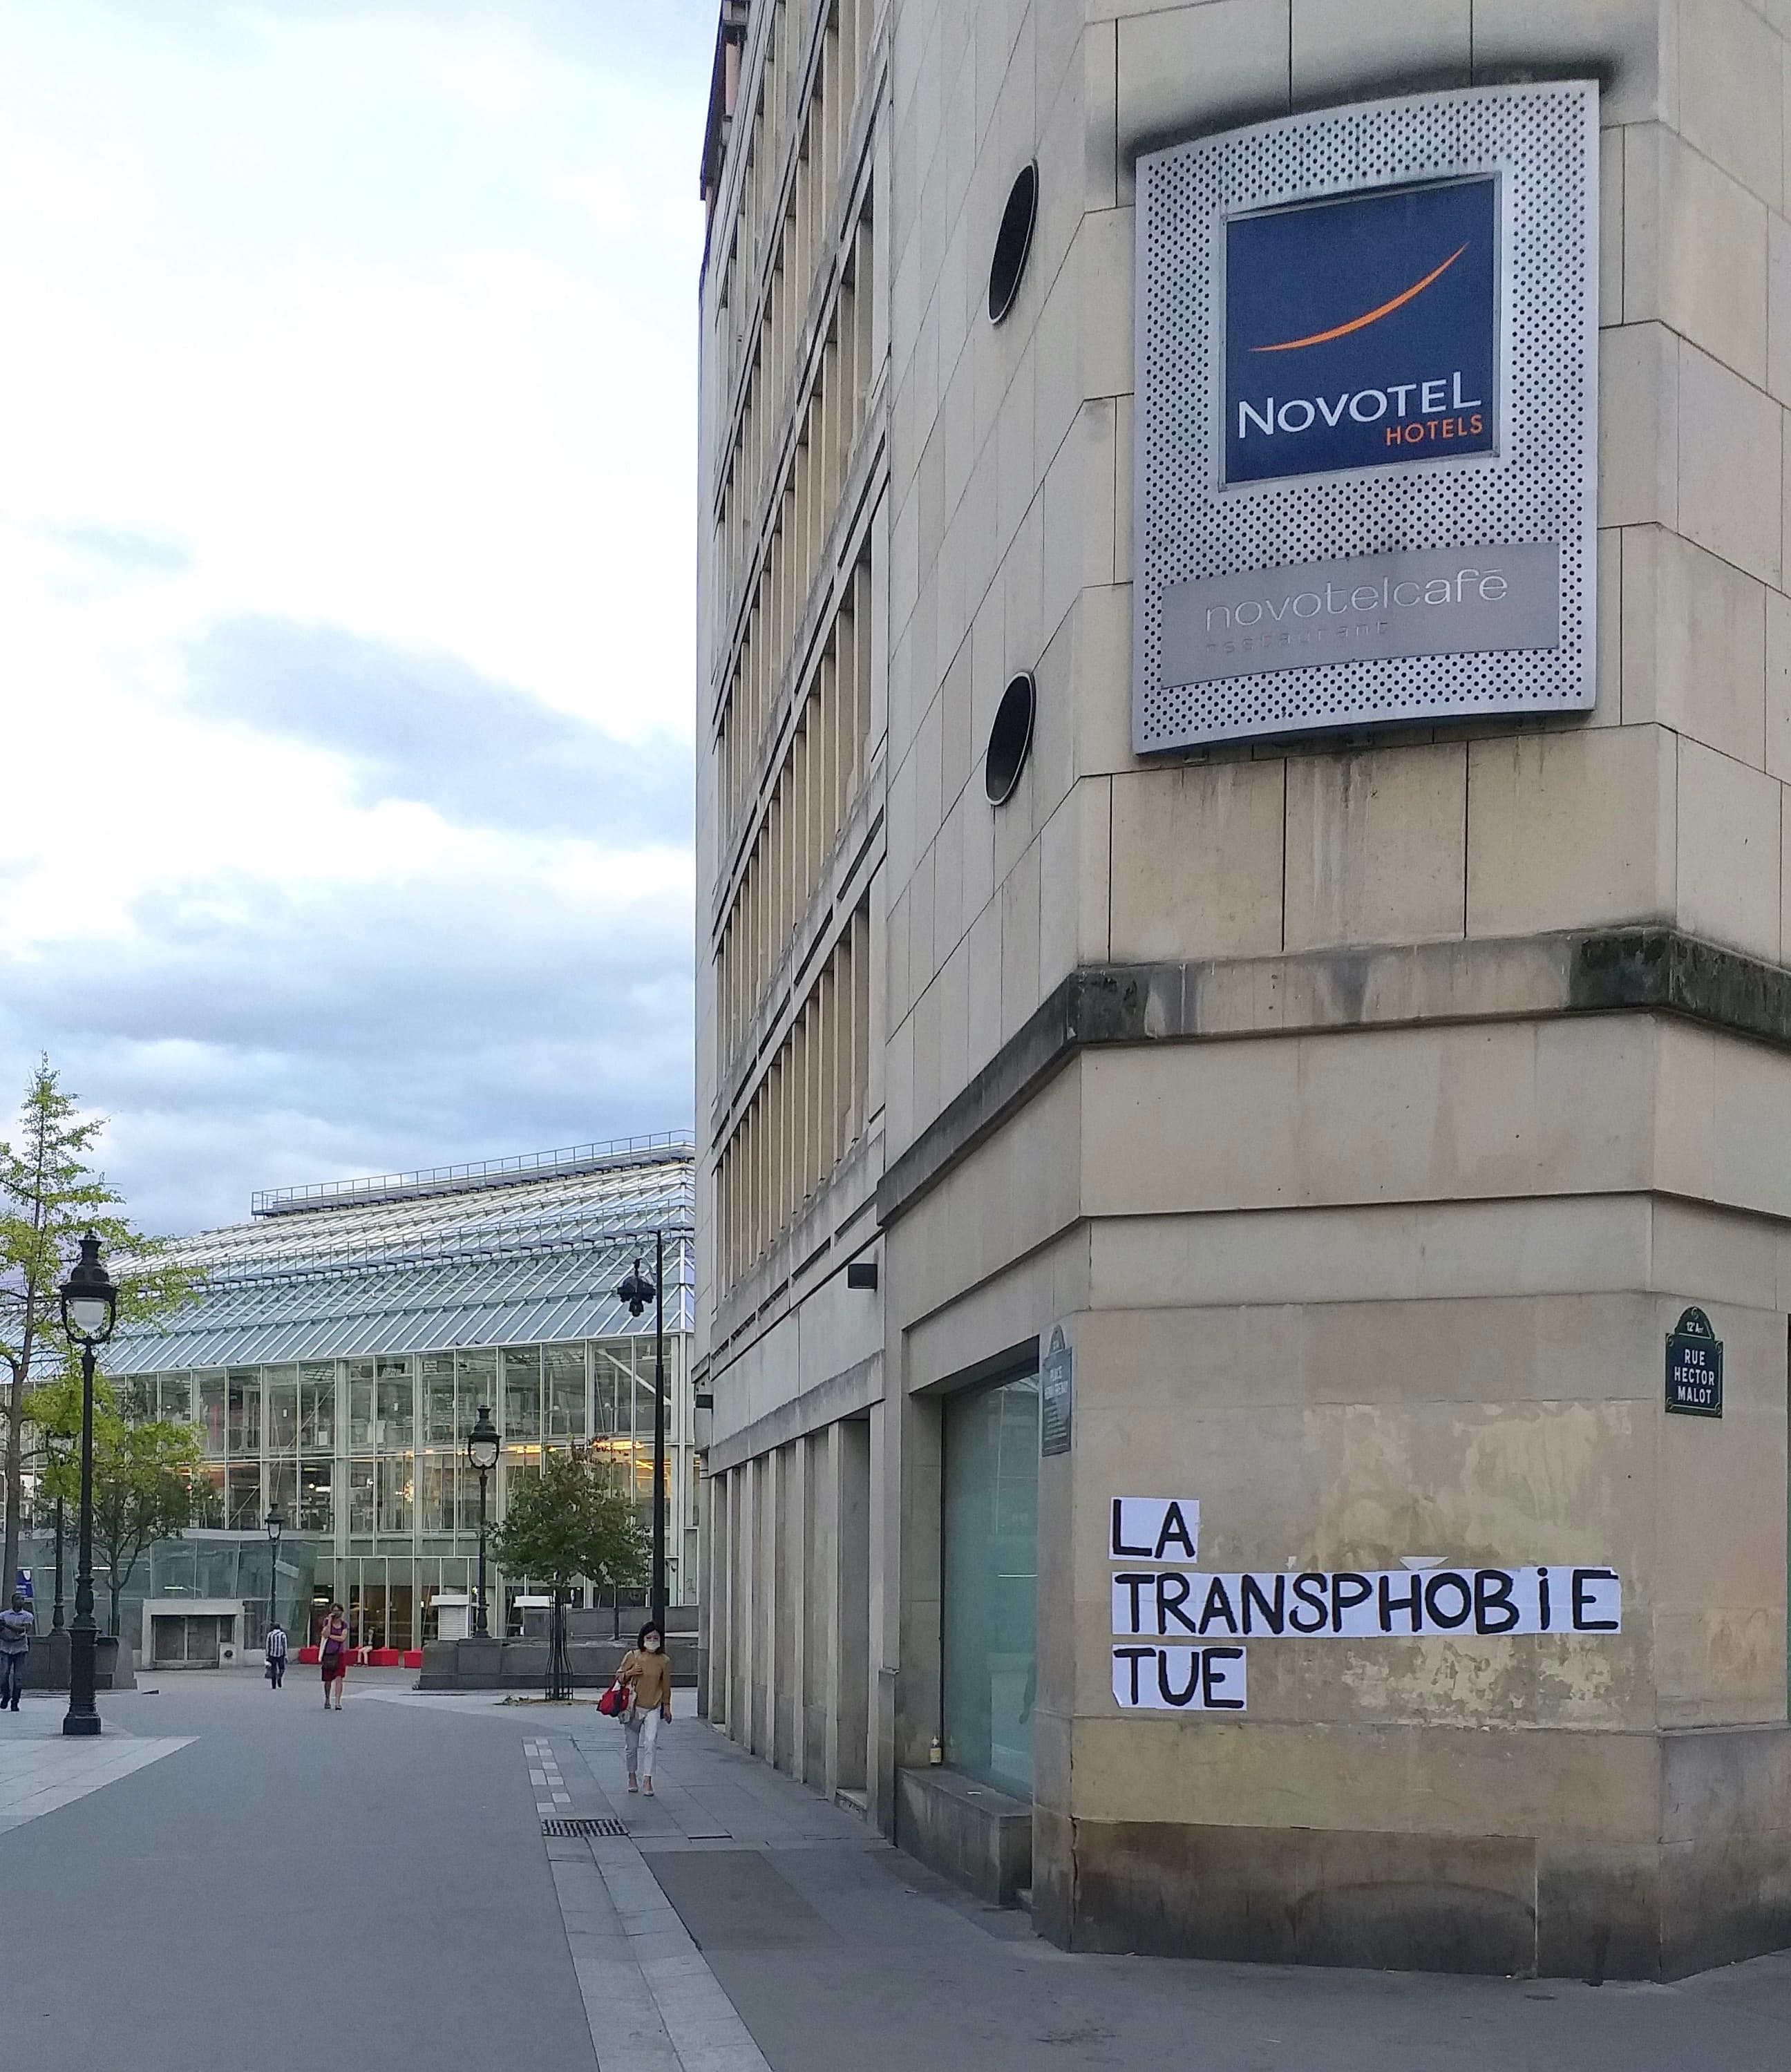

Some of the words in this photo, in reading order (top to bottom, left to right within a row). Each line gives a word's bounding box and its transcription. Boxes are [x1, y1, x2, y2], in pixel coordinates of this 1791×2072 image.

[1239, 371, 1482, 439] NOVOTEL
[1386, 414, 1483, 446] HOTELS
[1685, 1348, 1705, 1366] RUE
[1674, 1366, 1715, 1386] HECTOR
[1677, 1385, 1712, 1404] MALOT
[1112, 1499, 1195, 1559] LA
[1113, 1647, 1244, 1709] TUE
